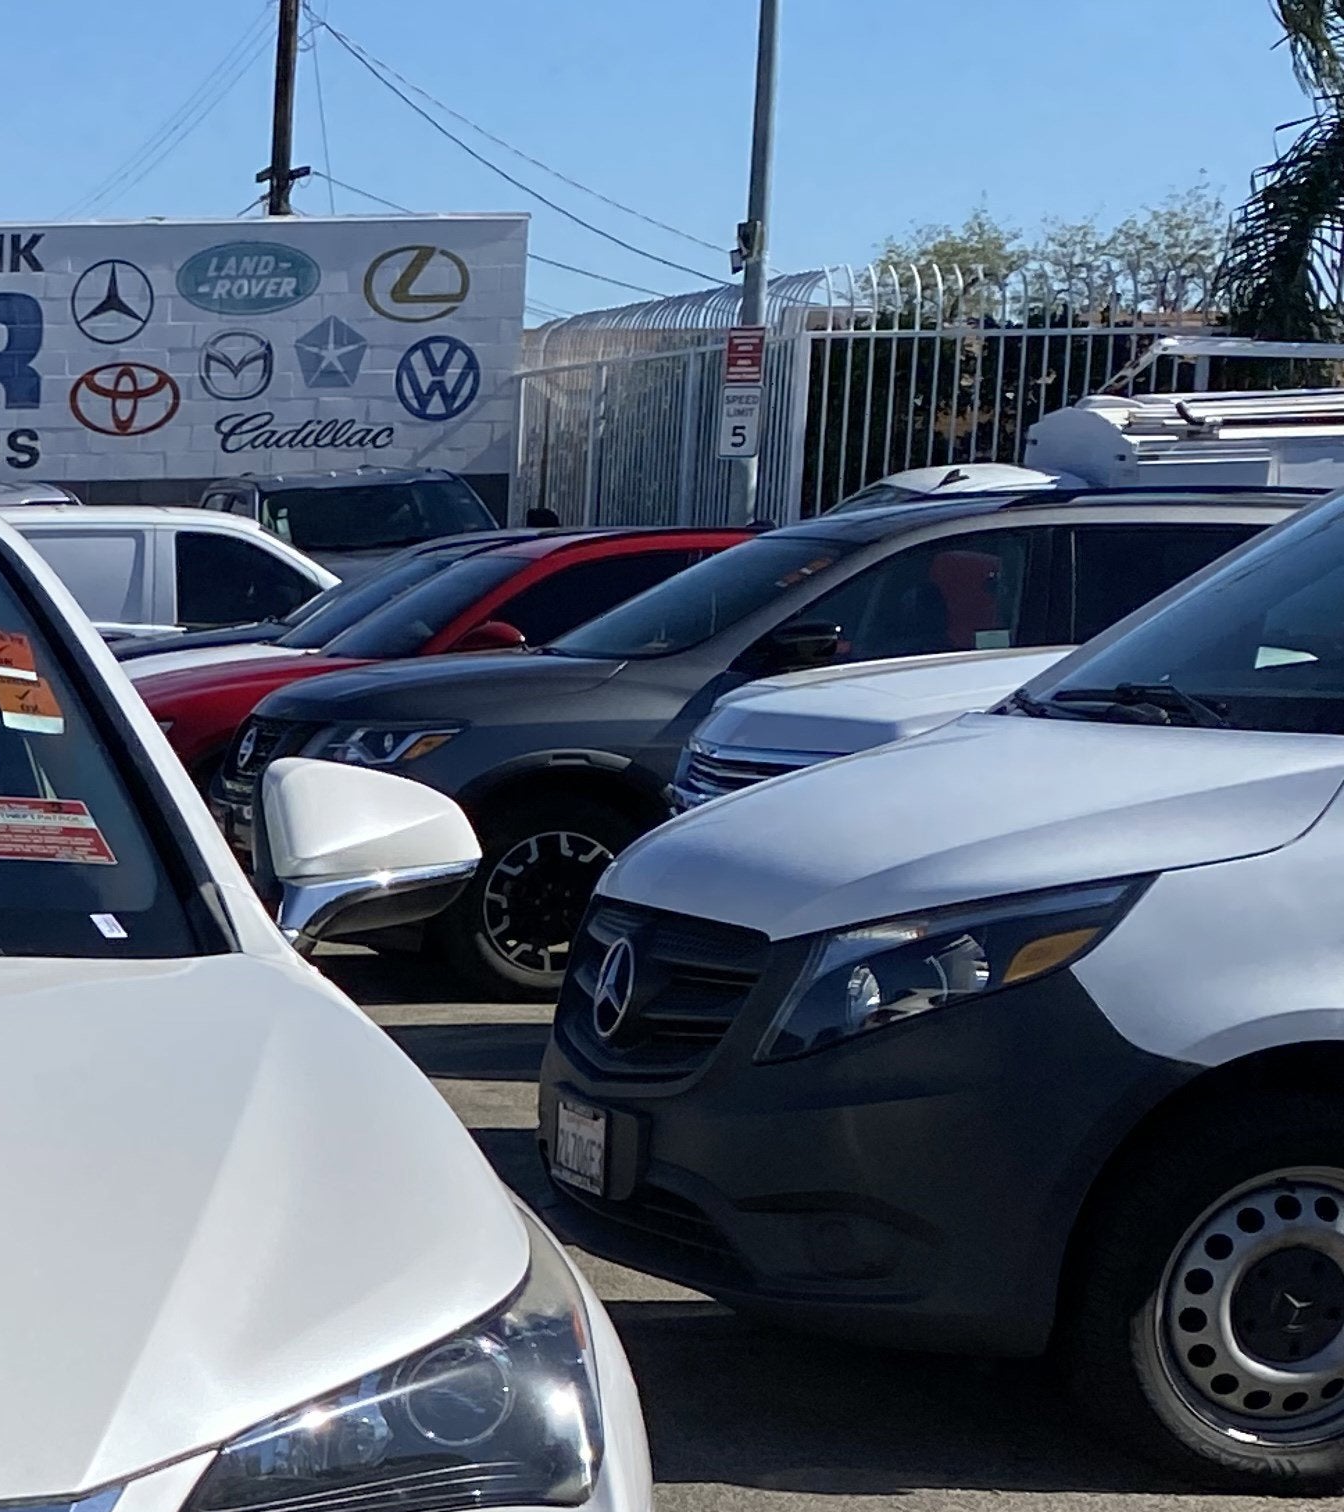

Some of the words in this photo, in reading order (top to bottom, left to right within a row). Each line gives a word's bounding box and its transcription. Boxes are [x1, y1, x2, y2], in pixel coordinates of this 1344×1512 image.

[725, 395, 759, 405] SPEED
[726, 407, 754, 417] LIMIT
[214, 411, 394, 454] Cadillac
[730, 425, 746, 447] 5
